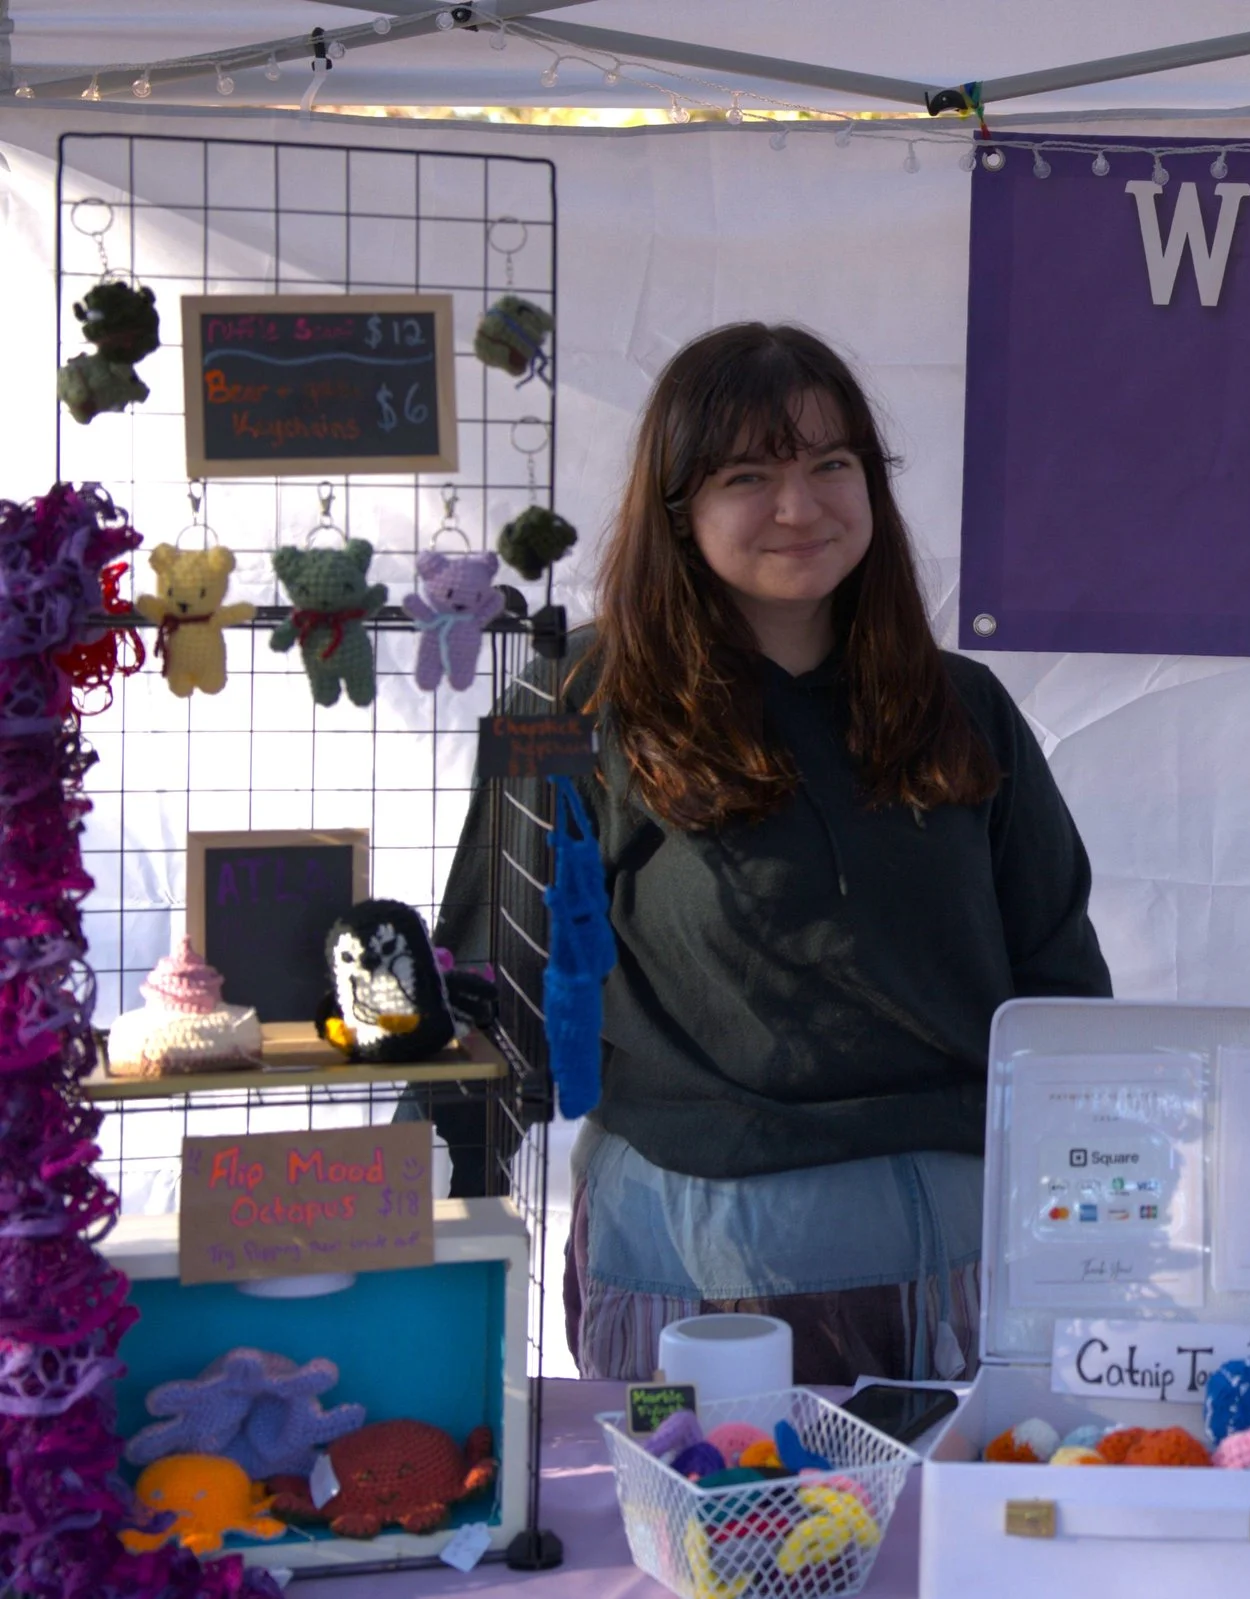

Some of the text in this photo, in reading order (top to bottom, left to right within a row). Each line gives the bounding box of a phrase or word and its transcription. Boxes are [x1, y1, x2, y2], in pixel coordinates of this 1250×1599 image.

[376, 382, 430, 433] $6
[208, 1144, 387, 1196] Flip Mood
[1091, 1152, 1140, 1167] Square
[229, 1186, 421, 1230] Octopus $18
[1076, 1338, 1175, 1401] Catnip
